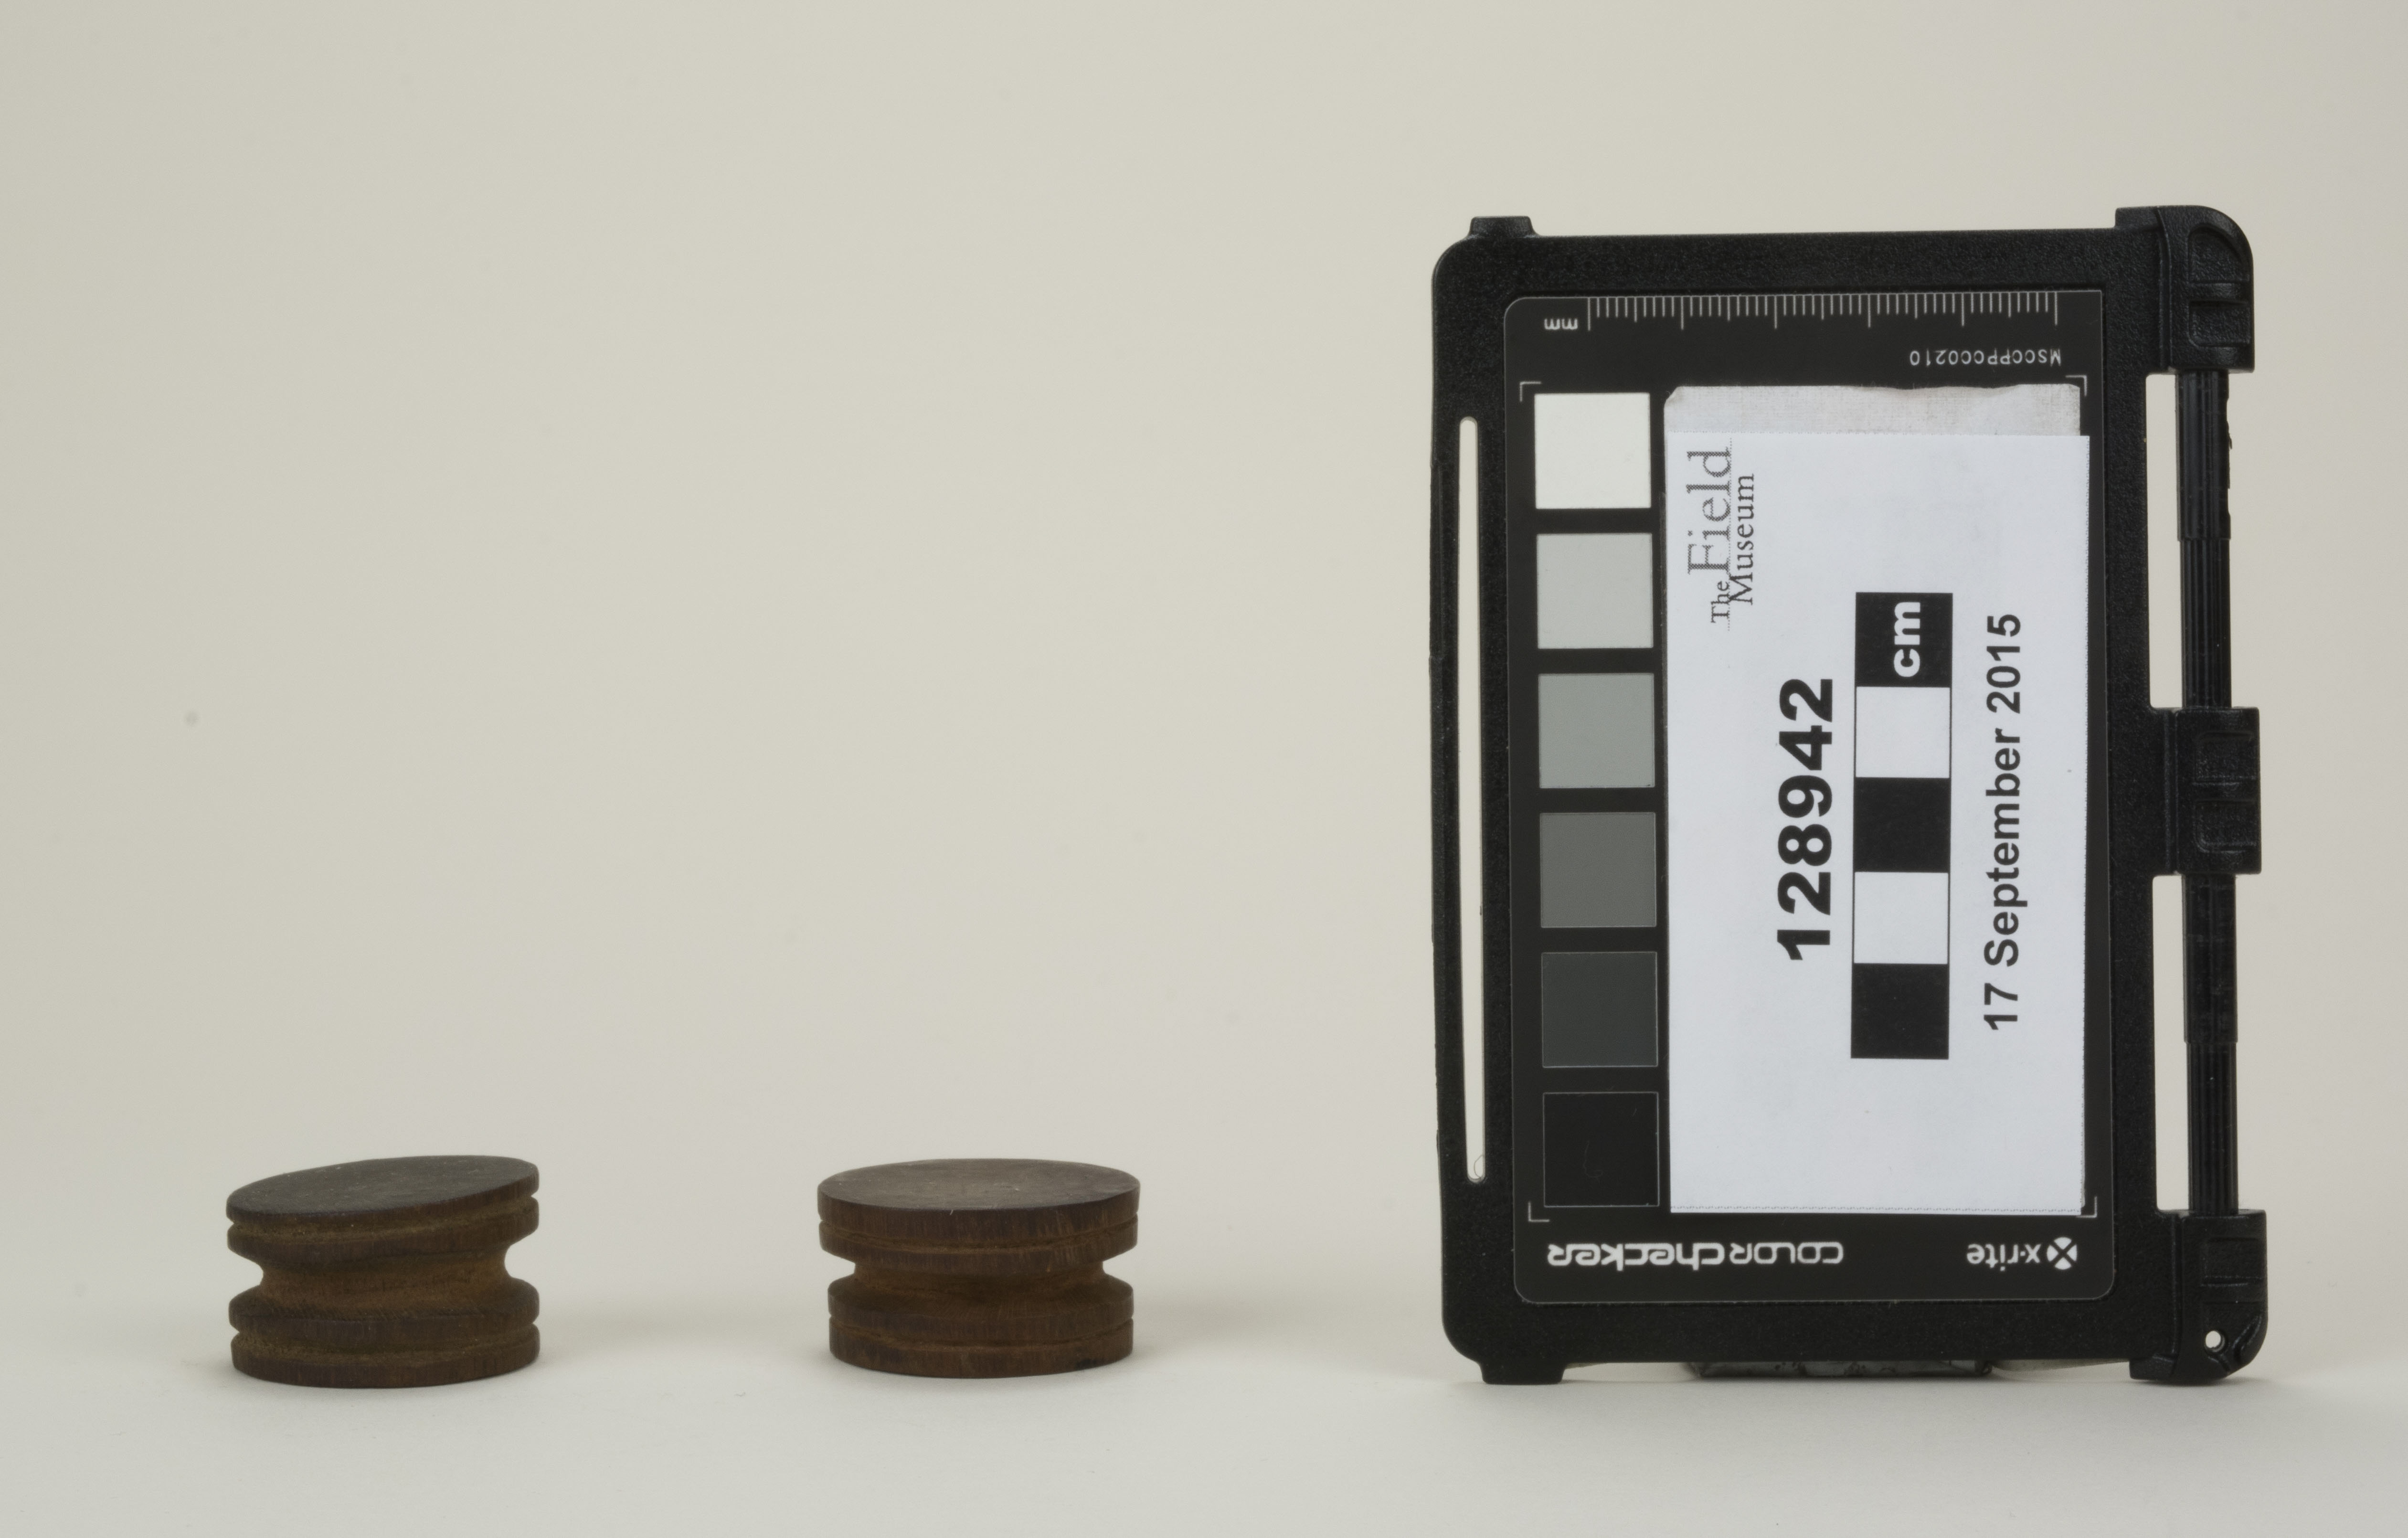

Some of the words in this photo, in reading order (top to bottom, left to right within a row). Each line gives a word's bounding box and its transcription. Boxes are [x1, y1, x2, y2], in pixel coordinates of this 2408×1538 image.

[1544, 318, 1578, 330] mm
[1686, 447, 1732, 574] Field
[1729, 473, 1754, 605] Museum
[1710, 581, 1730, 623] The
[1893, 602, 1920, 677] cm
[1986, 614, 2021, 714] 2015
[1777, 679, 1833, 960] 128942
[1984, 728, 2028, 967] September
[1984, 983, 2018, 1030] 17
